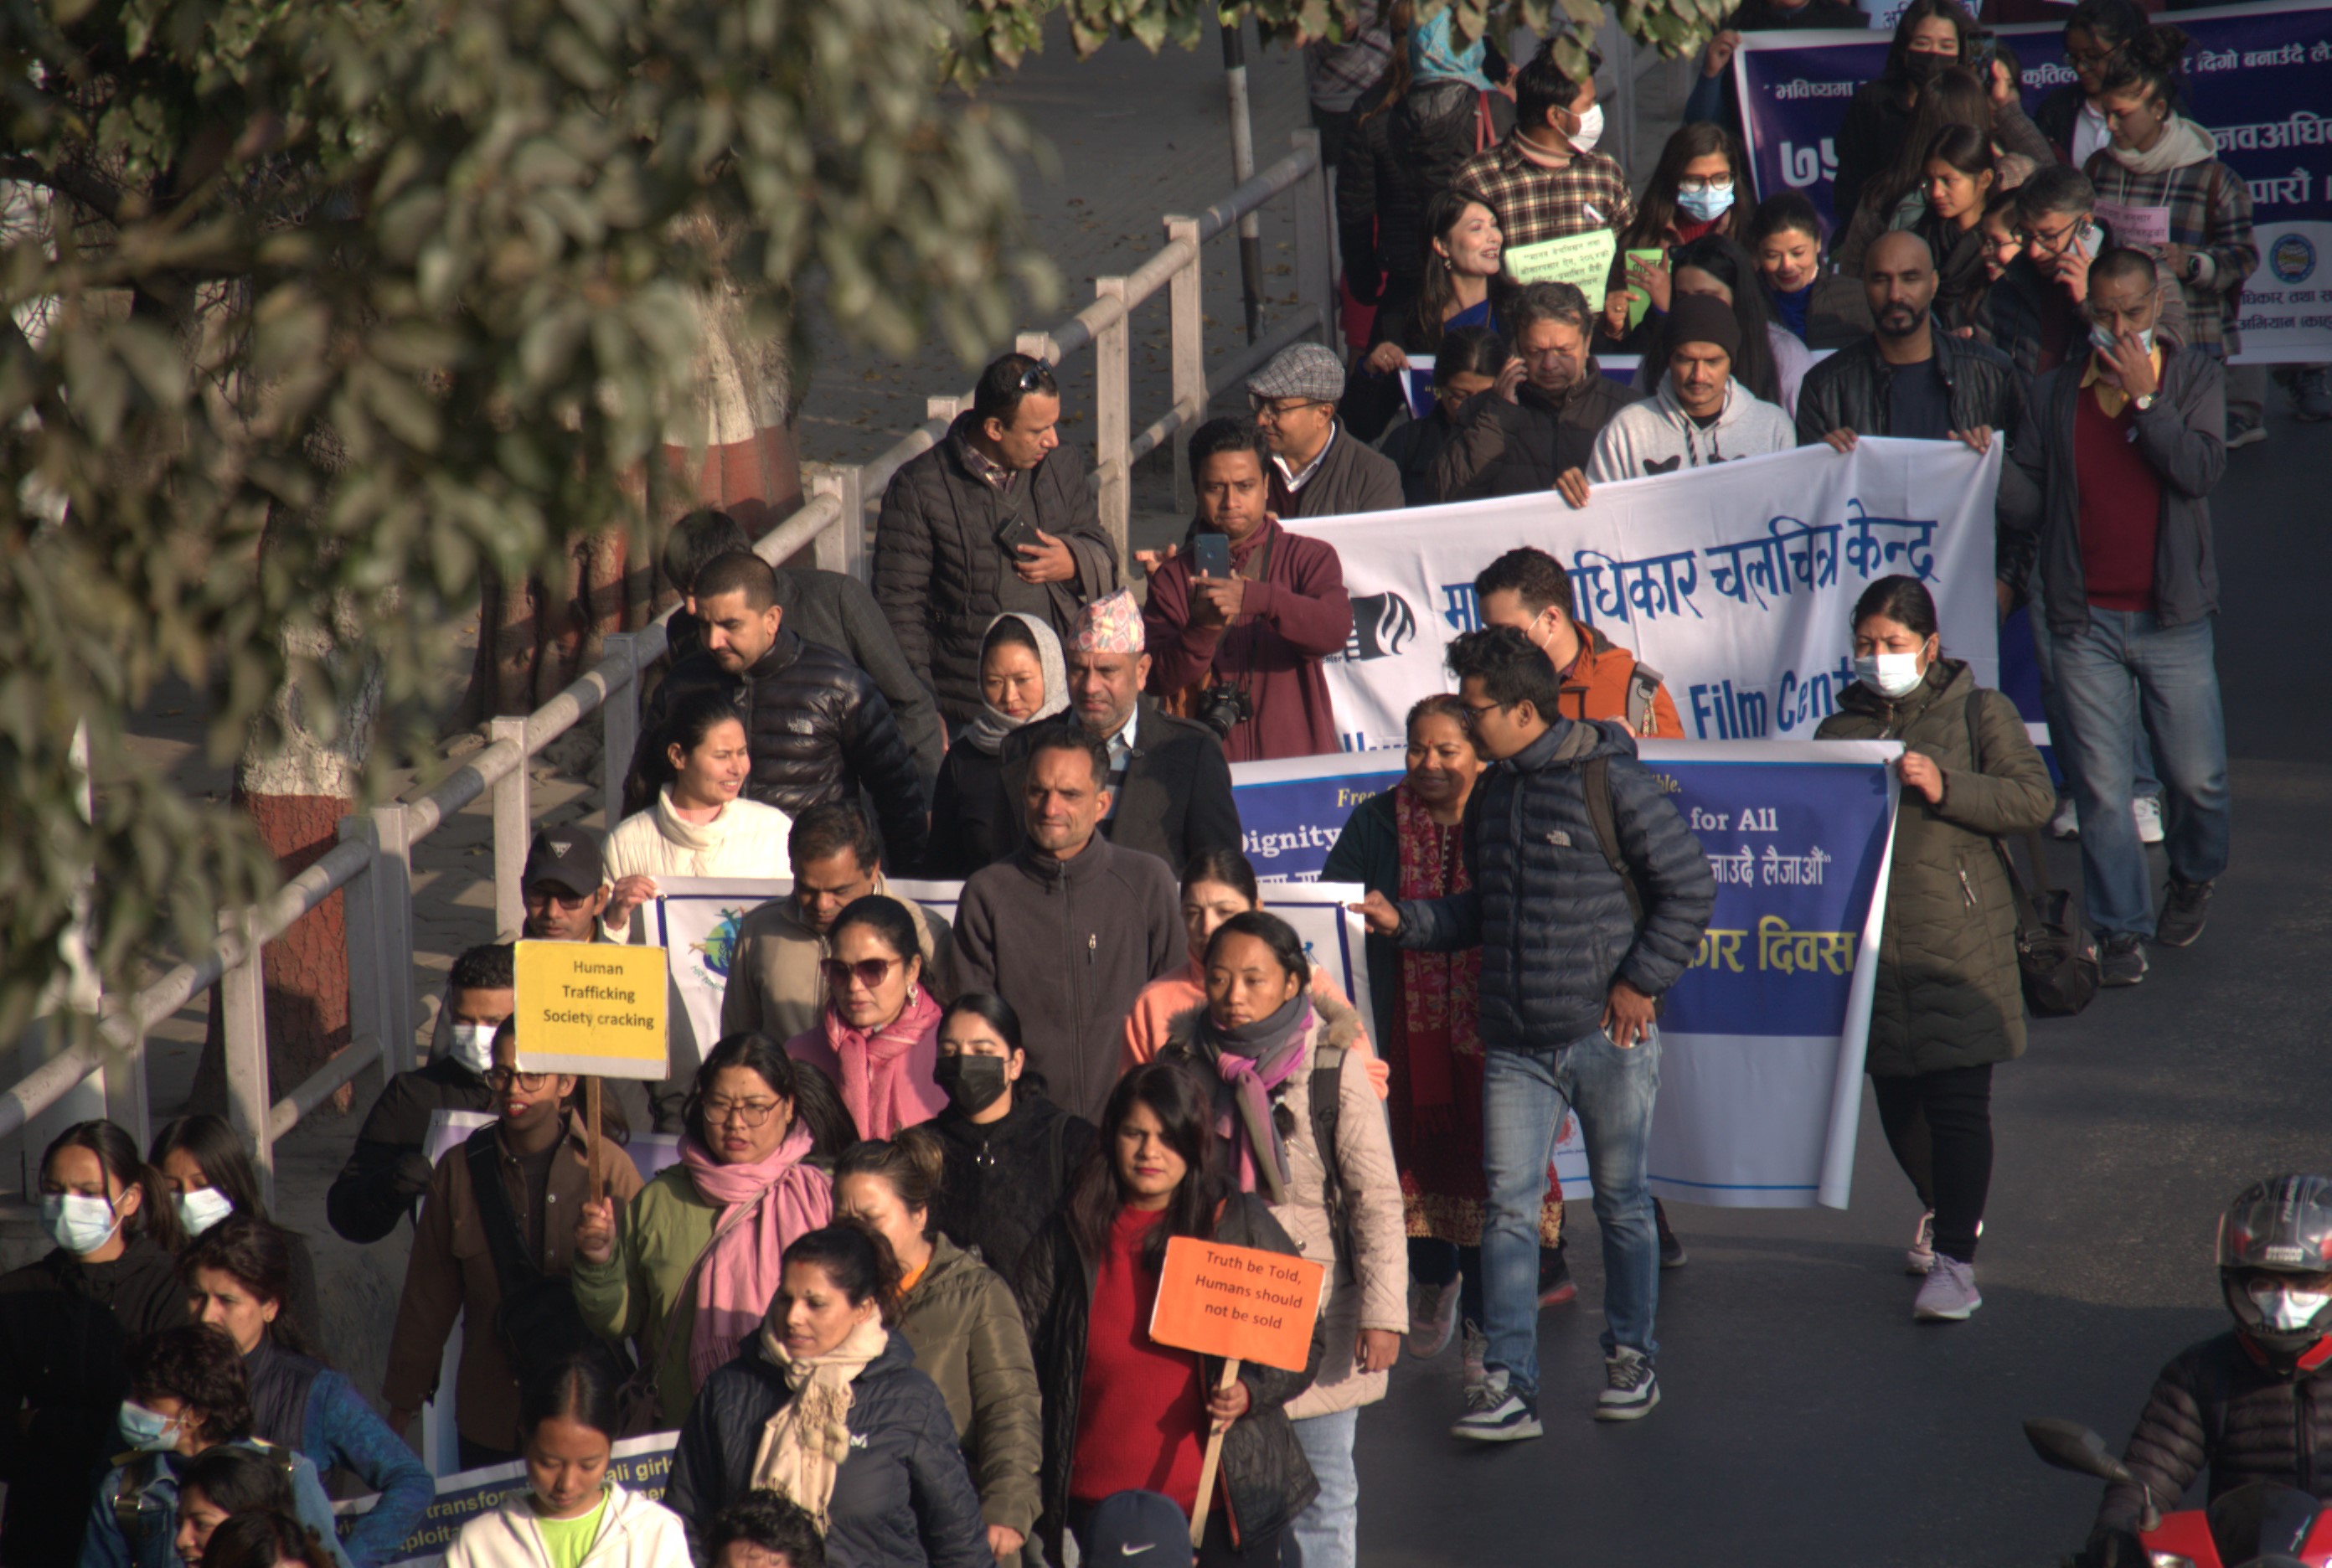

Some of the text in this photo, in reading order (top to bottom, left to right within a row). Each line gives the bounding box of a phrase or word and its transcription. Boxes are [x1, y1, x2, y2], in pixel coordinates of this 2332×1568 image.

[1689, 656, 1858, 740] Film Cent
[1690, 807, 1730, 831] for
[1738, 807, 1779, 832] All
[1686, 915, 1857, 975] कार दिवस
[573, 961, 623, 976] Human
[562, 985, 635, 1003] Trafficking
[544, 1009, 654, 1030] Society cracking
[1206, 1251, 1302, 1285] Truth be Told,
[1194, 1274, 1303, 1308] Humans should
[1204, 1302, 1282, 1329] not be sold
[426, 1490, 508, 1519] transfor
